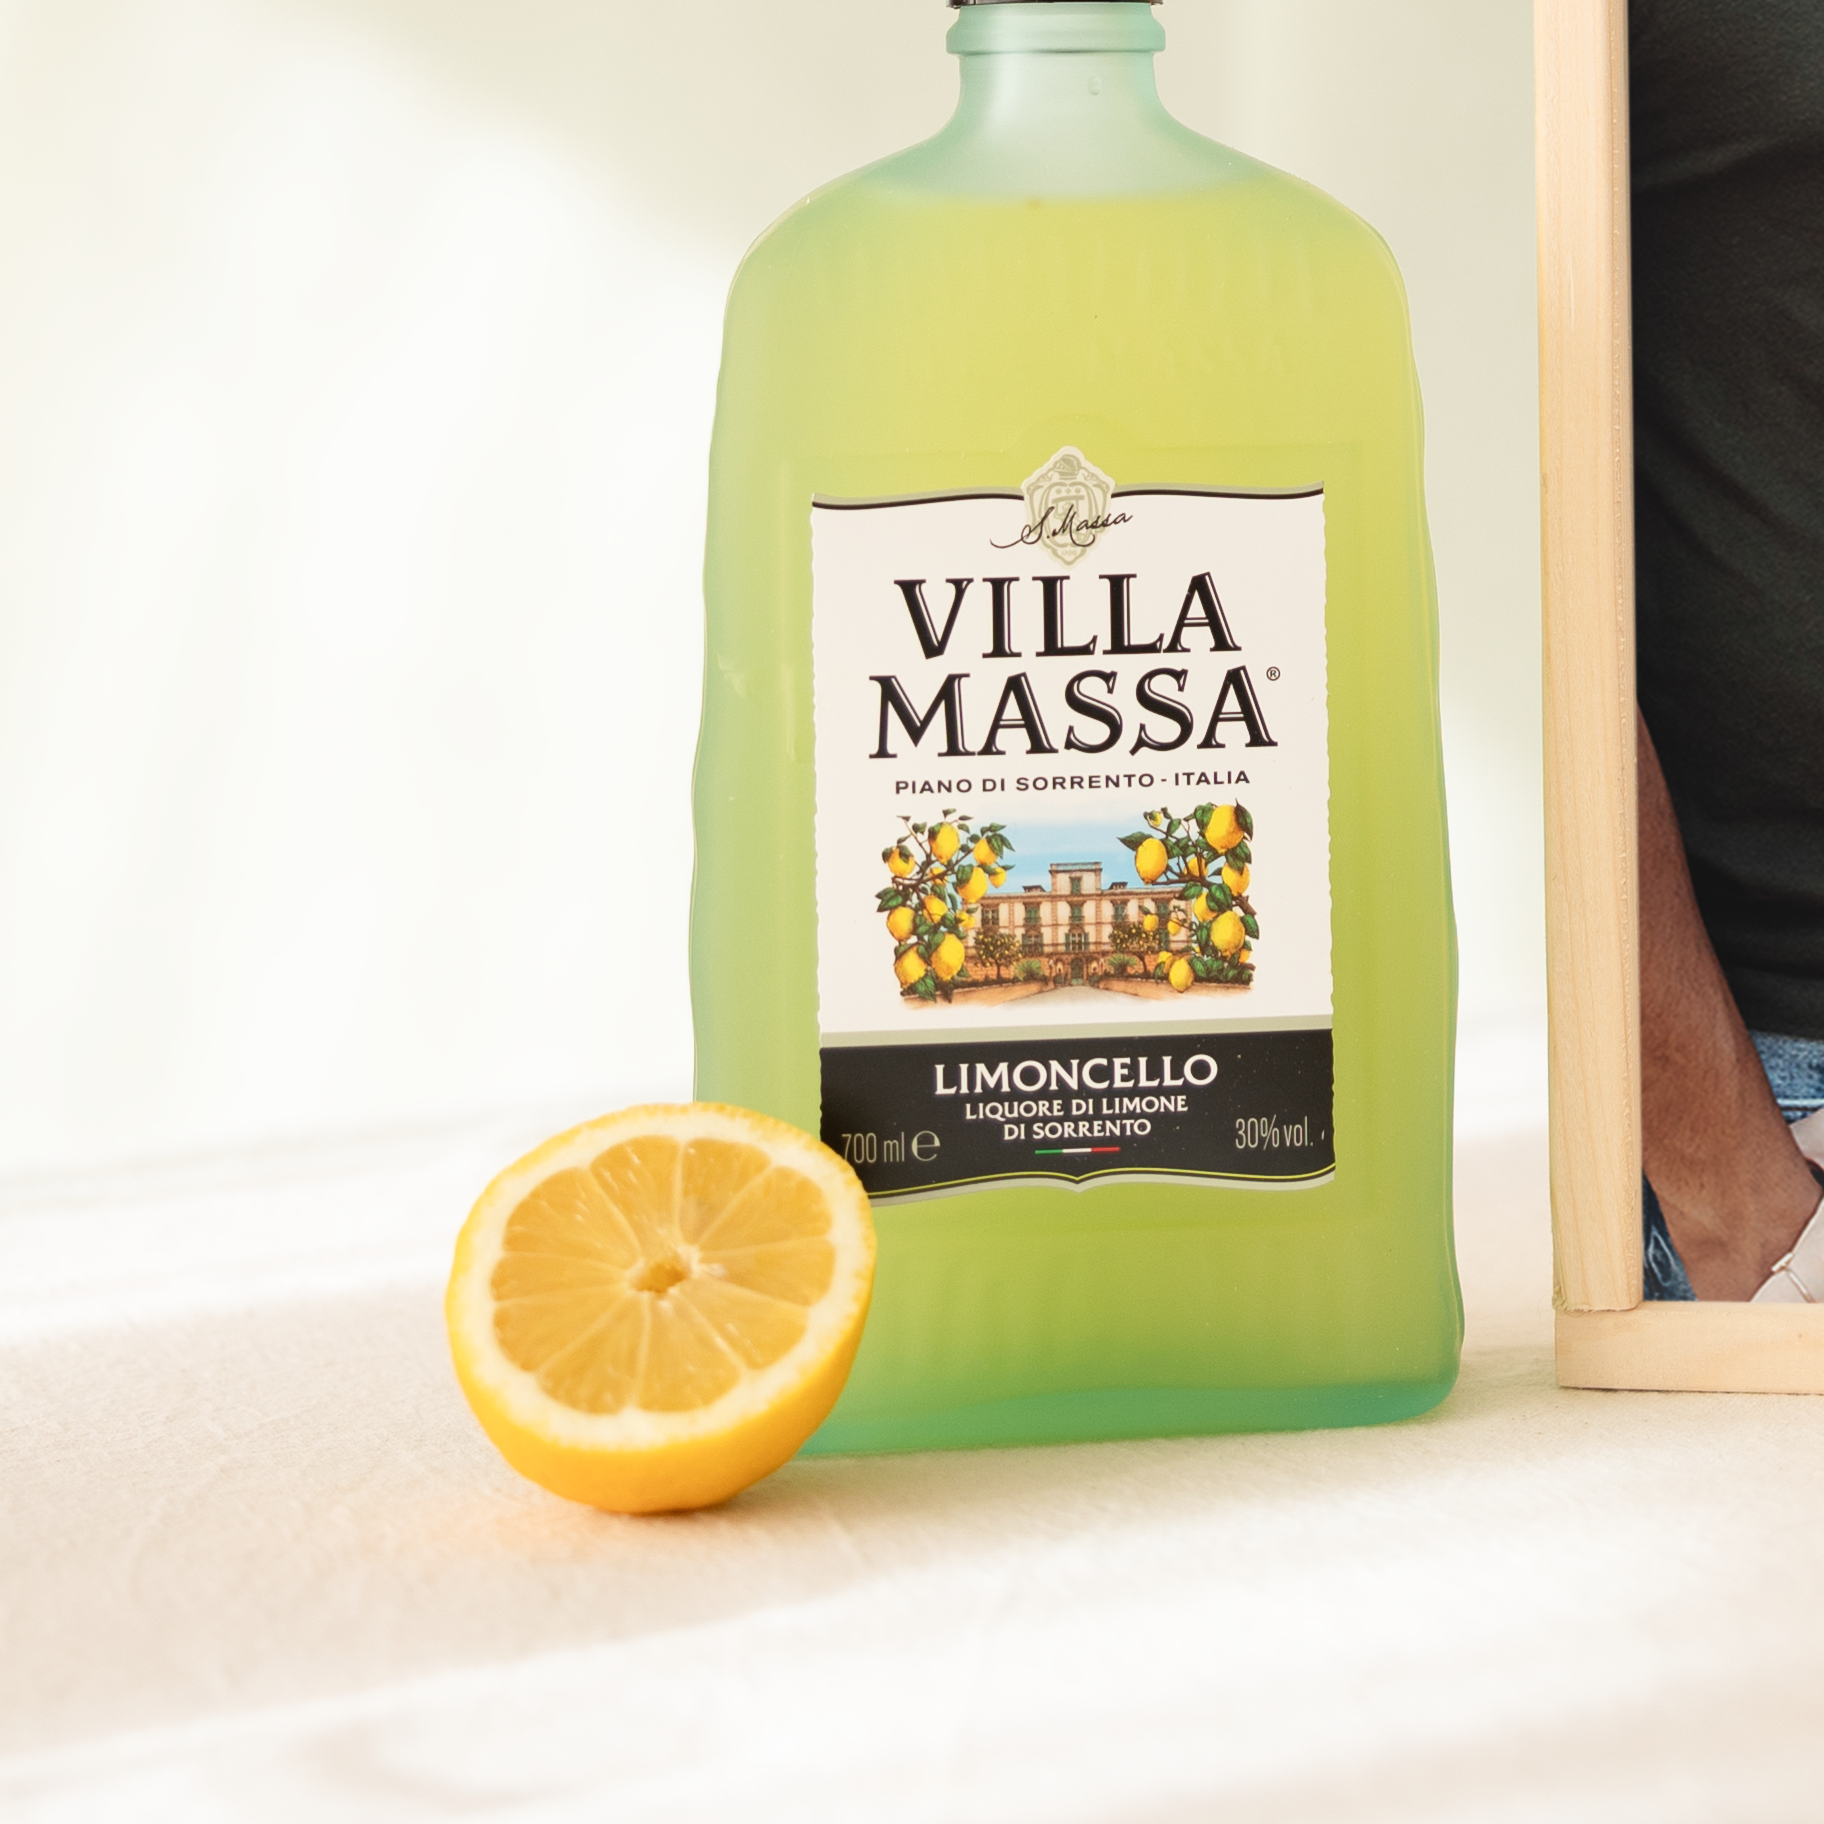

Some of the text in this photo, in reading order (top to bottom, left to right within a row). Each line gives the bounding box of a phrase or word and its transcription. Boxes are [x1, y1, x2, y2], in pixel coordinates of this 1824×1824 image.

[893, 571, 1242, 660] VILLA
[895, 779, 973, 795] PIANO
[981, 778, 1006, 793] DI
[1015, 773, 1155, 792] SORRENTO
[1173, 769, 1251, 787] ITALIA
[934, 1053, 1218, 1096] LIMONCELLO
[965, 1094, 1189, 1123] LIQUORE DI LIMONE
[1003, 1117, 1152, 1142] DI SORRENTO
[841, 1132, 877, 1164] 700
[883, 1131, 905, 1163] ml
